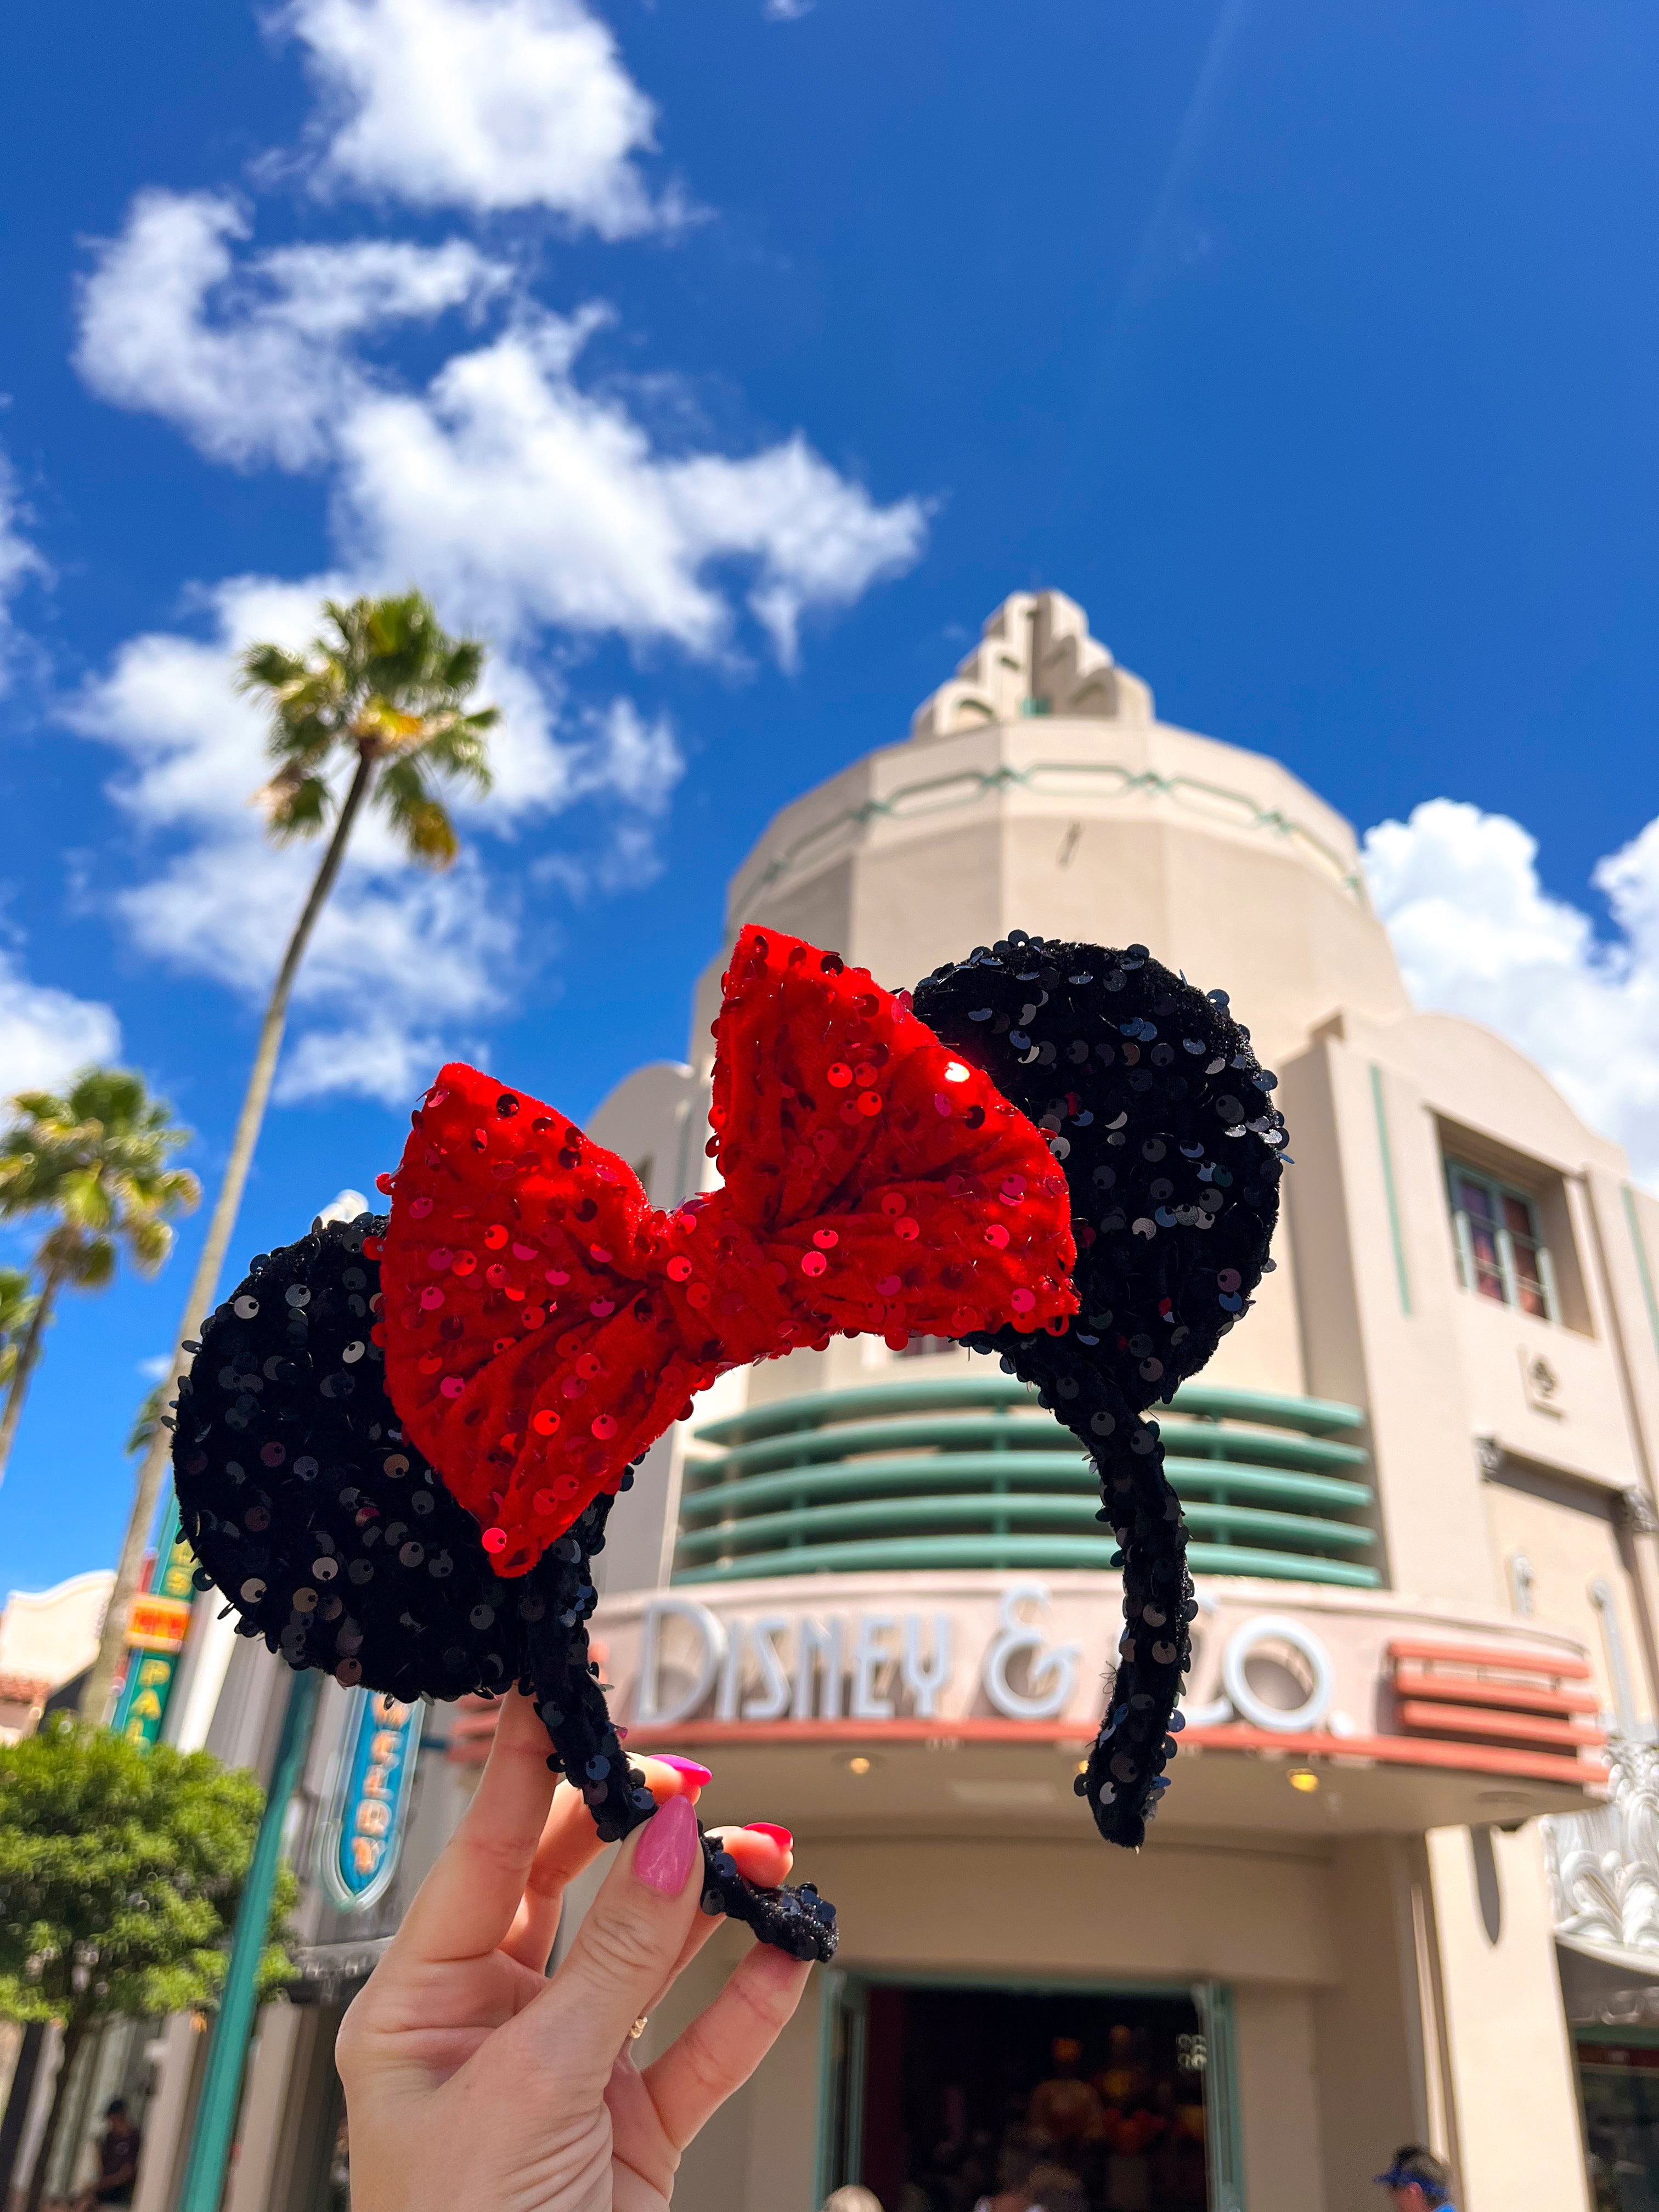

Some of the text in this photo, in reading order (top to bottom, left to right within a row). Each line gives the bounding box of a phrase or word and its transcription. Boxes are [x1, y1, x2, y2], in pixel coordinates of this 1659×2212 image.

[633, 1582, 1357, 1739] DISNEY & O.
